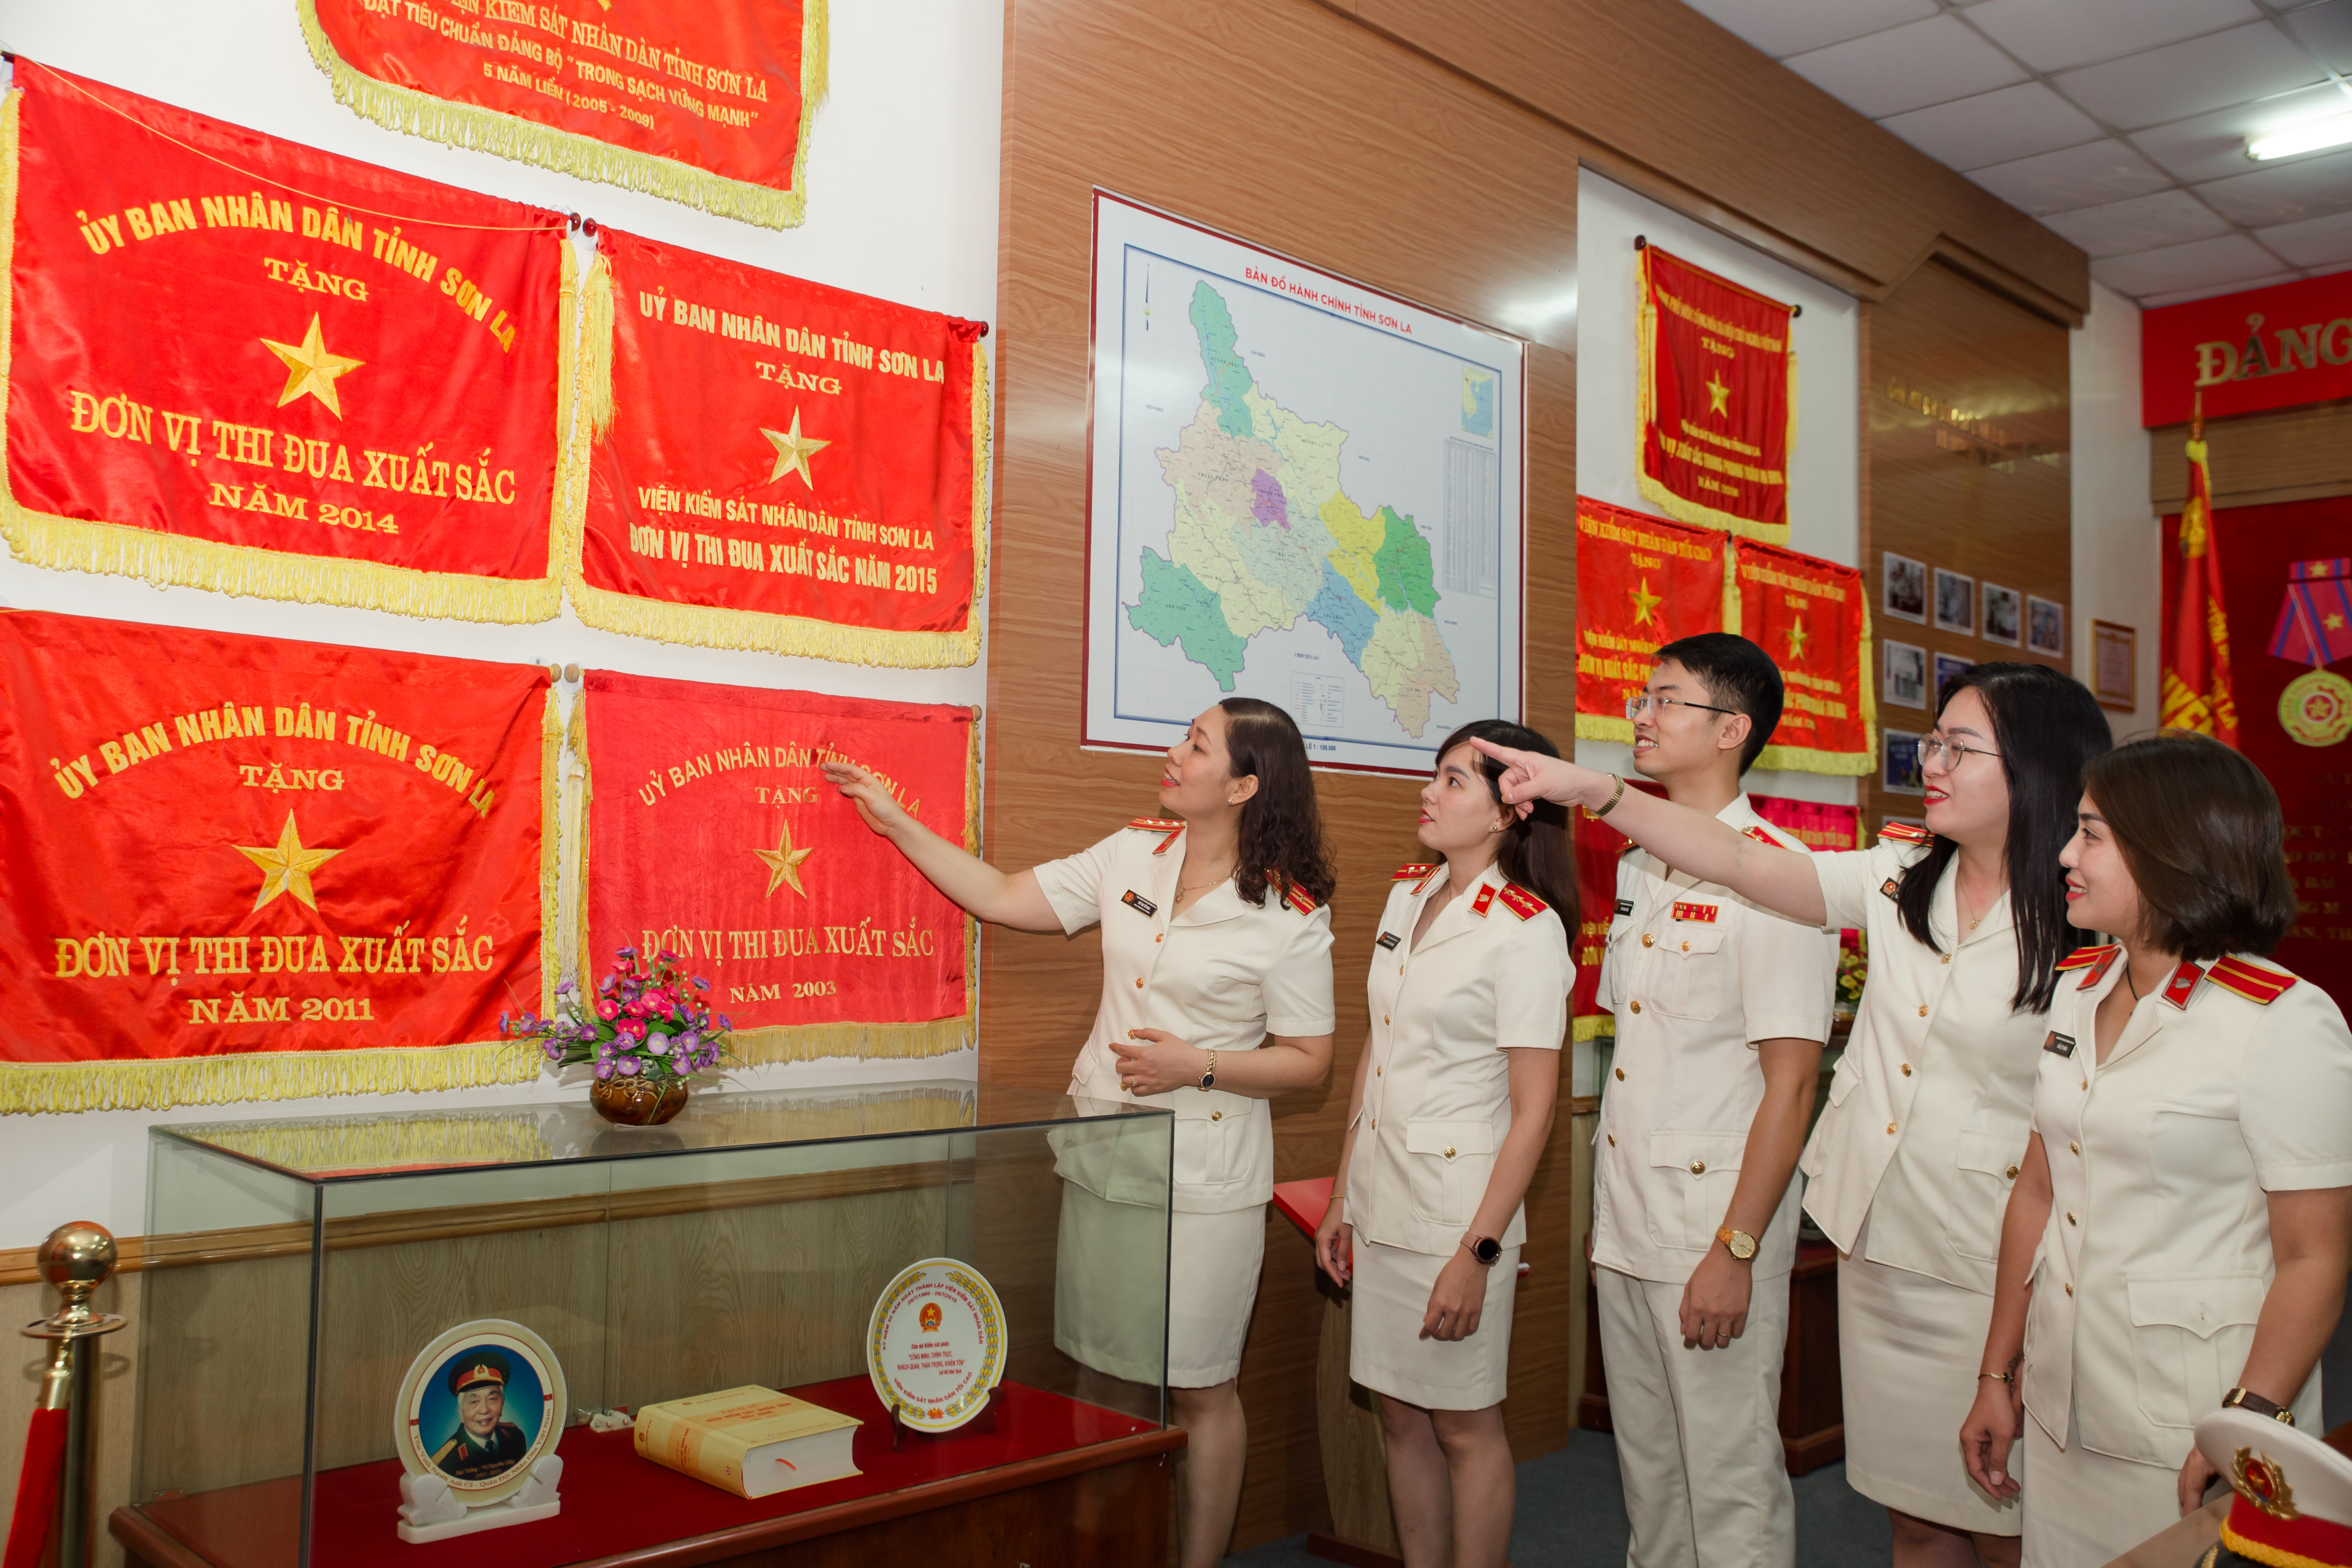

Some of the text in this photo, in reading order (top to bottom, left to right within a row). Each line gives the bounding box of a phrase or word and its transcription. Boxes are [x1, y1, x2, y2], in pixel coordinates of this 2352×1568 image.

[404, 1, 438, 30] TIÊU
[440, 16, 493, 49] CHUẨN
[497, 30, 542, 62] ĐẢNG
[545, 47, 563, 74] BỘ
[627, 77, 665, 102] SẠCH
[668, 88, 704, 117] VỮNG
[539, 4, 767, 102] SÁT NHÂN DÂN TỈNH SƠN LA
[483, 62, 654, 129] 5 NĂM LIỀN 2009)
[124, 198, 197, 241] BAN
[200, 191, 293, 232] NHÂN
[302, 206, 363, 251] DÂN
[373, 226, 438, 282] TỈNH
[440, 268, 492, 322] SƠN
[490, 310, 515, 352] LA
[264, 257, 369, 301] TẶNG
[1246, 266, 1412, 334] BẢN ĐỒ HÀNH CHÍNH TỈNH SƠN LA
[674, 299, 715, 334] BAN
[722, 312, 780, 348] NHÂN
[786, 327, 825, 358] DÂN
[832, 331, 873, 369] TỈNH
[879, 349, 918, 378] SƠN
[922, 358, 944, 383] LA
[2194, 312, 2352, 387] ĐẢNG
[756, 361, 842, 395] TẶNG
[70, 390, 514, 505] ĐƠN VỊ THI ĐUA XUẤT SẮC
[209, 482, 398, 534] NĂM 2014
[638, 484, 680, 516] VIỆN
[685, 489, 721, 519] KIỂM
[726, 496, 758, 523] SÁT
[843, 514, 876, 543] TỈNH
[879, 525, 910, 548] SƠN
[914, 530, 934, 550] LA
[630, 522, 937, 594] ĐƠN VỊ THI ĐUA XUẤT SẮC NĂM 2015
[99, 722, 172, 774] BAN
[174, 701, 265, 747] NHÂN
[275, 702, 336, 741] DÂN
[347, 710, 410, 762] TỈNH
[415, 744, 474, 793] SƠN
[469, 778, 495, 818] LA
[239, 762, 344, 793] TẶNG
[668, 754, 711, 788] BAN
[716, 742, 769, 772] NHÂN
[775, 741, 811, 767] DÂN
[897, 787, 921, 819] LA
[755, 787, 818, 809] TẶNG
[55, 915, 492, 986] ĐƠN VỊ THI ĐUA XUẤT SẮC
[642, 917, 933, 966] ĐƠN VỊ THI ĐUA XUẤT SẮC
[188, 991, 374, 1024] NĂM 2011
[730, 981, 836, 1003] NĂM 2003
[901, 1289, 914, 1302] NGÀY
[916, 1283, 933, 1292] THÀNH
[946, 1285, 957, 1293] VIỆN
[957, 1291, 968, 1302] KIỂM
[967, 1301, 976, 1311] SÁT
[973, 1312, 982, 1329] NHÂN
[894, 1377, 903, 1391] VIỆN
[903, 1389, 915, 1400] KIỂM
[944, 1390, 956, 1401] DÂN
[955, 1383, 964, 1392] TỐI
[963, 1372, 972, 1384] CAO
